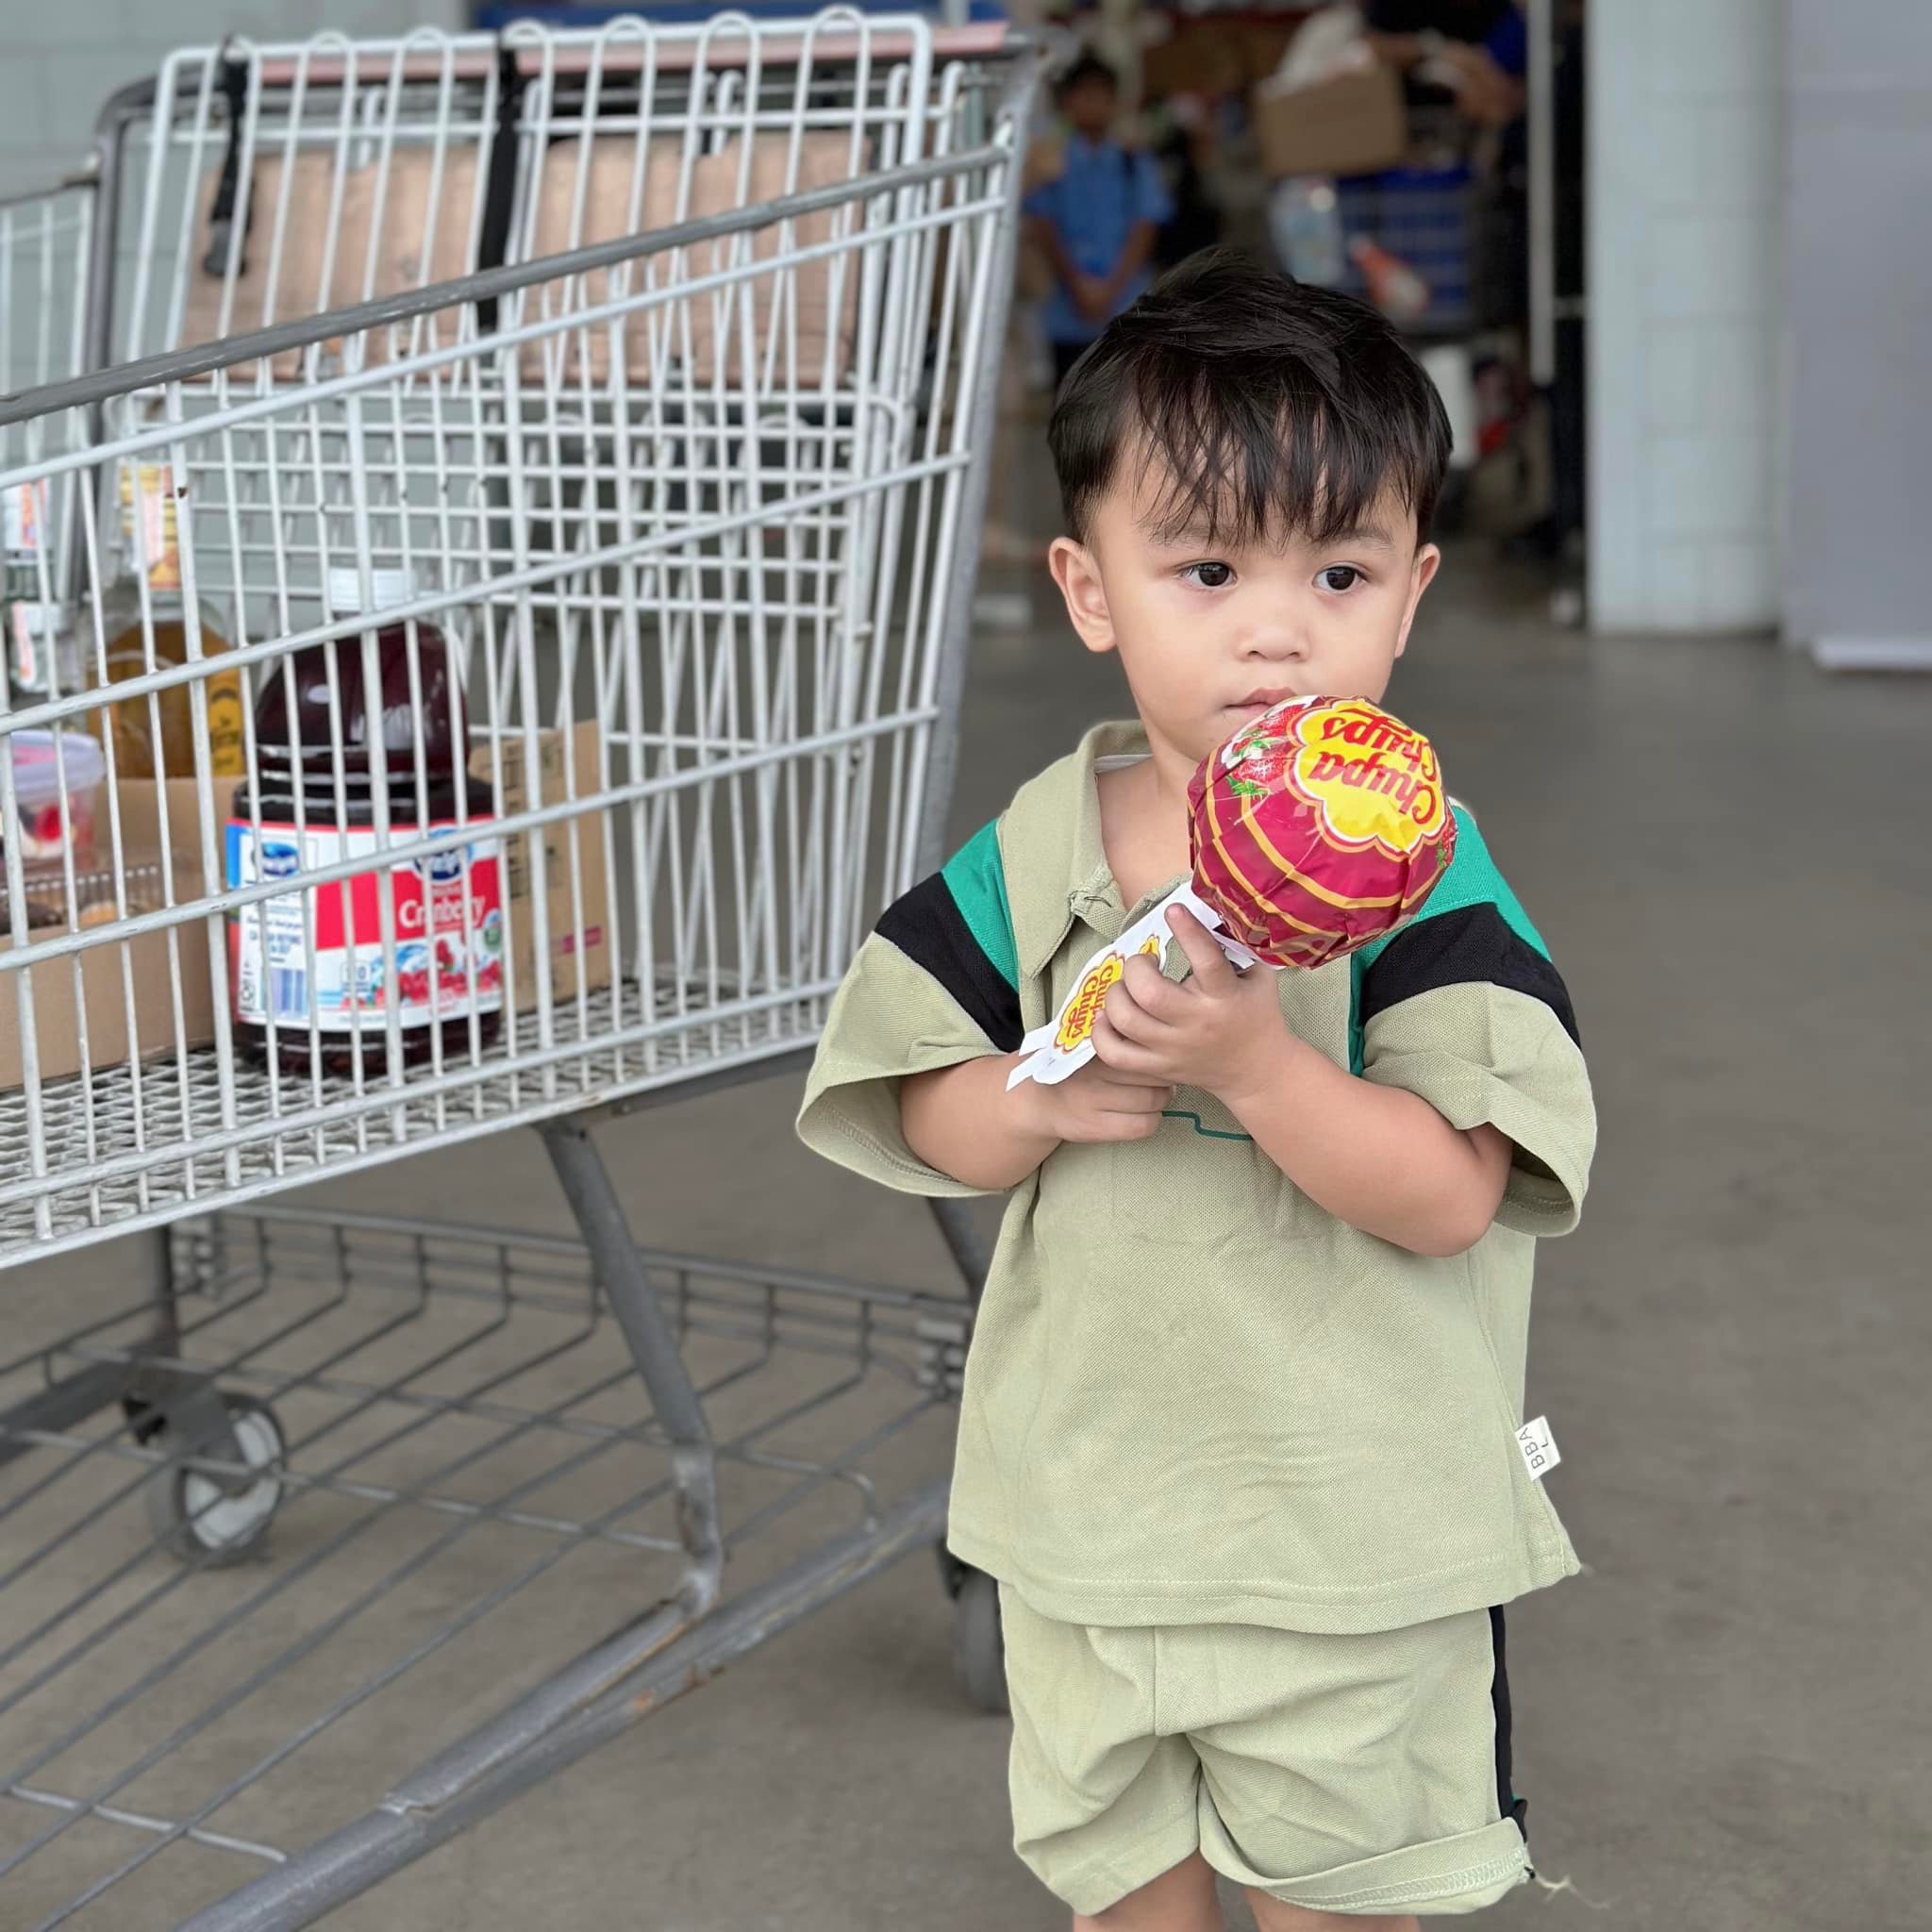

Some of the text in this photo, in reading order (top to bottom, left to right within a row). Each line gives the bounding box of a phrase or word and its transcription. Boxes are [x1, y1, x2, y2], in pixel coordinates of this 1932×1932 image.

[1320, 708, 1437, 782] Chups
[1307, 751, 1437, 824] Chupa
[399, 895, 486, 928] Crnbey
[1066, 975, 1099, 1039] Chups
[1519, 1427, 1546, 1469] BBA
